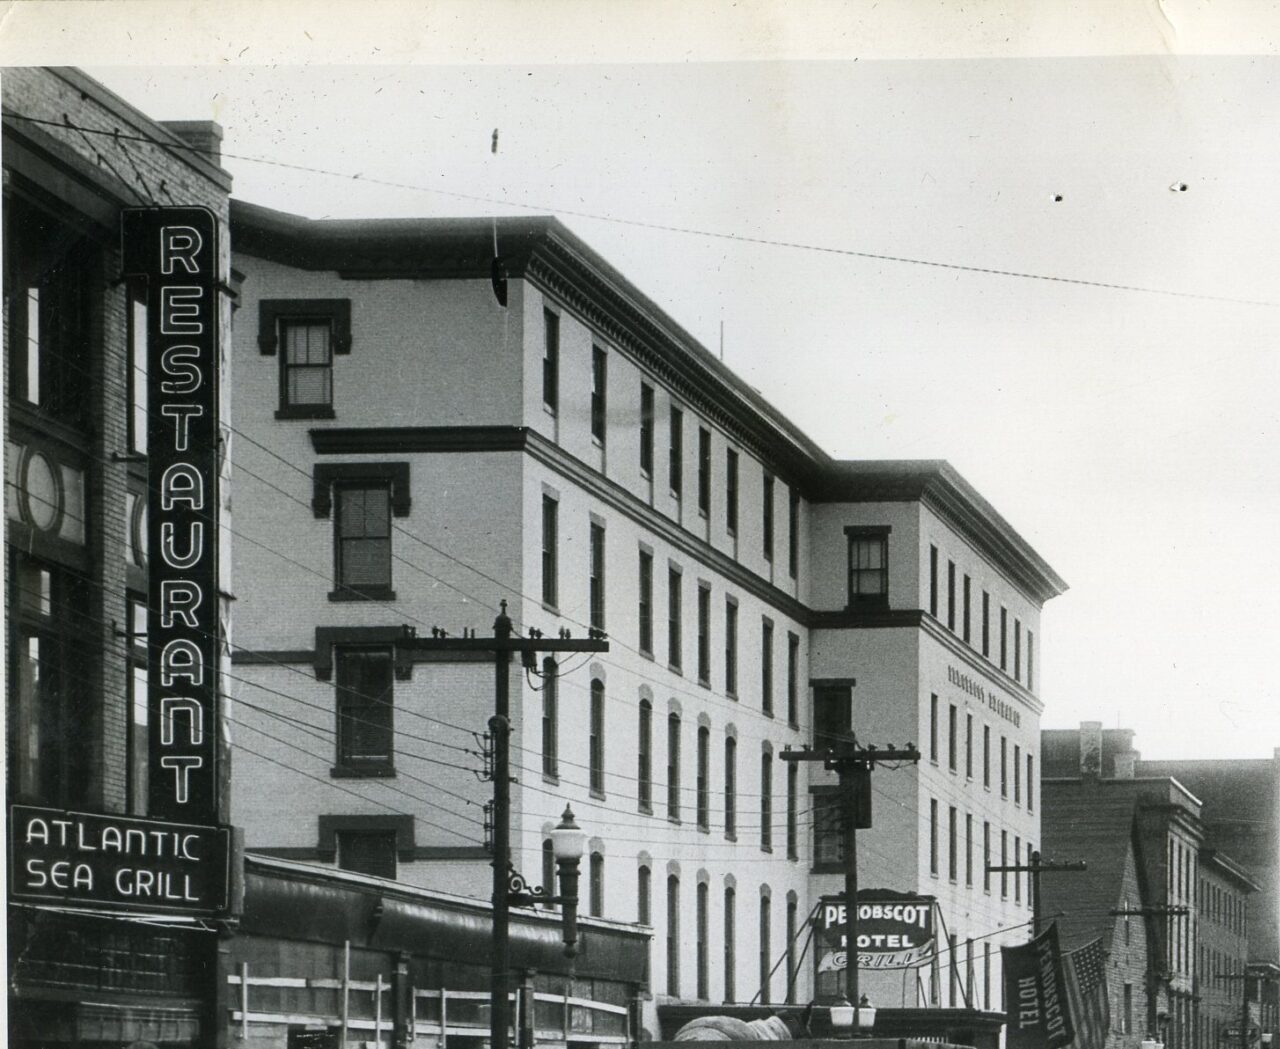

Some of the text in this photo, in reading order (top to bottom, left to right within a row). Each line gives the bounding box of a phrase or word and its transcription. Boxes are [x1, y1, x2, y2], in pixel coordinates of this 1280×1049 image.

[160, 226, 203, 803] RESTAURANT
[26, 818, 200, 861] ATLANTIC
[27, 859, 200, 901] SEA GRILL
[825, 905, 930, 929] PEOBSCOT
[1018, 976, 1040, 1029] HOTEL
